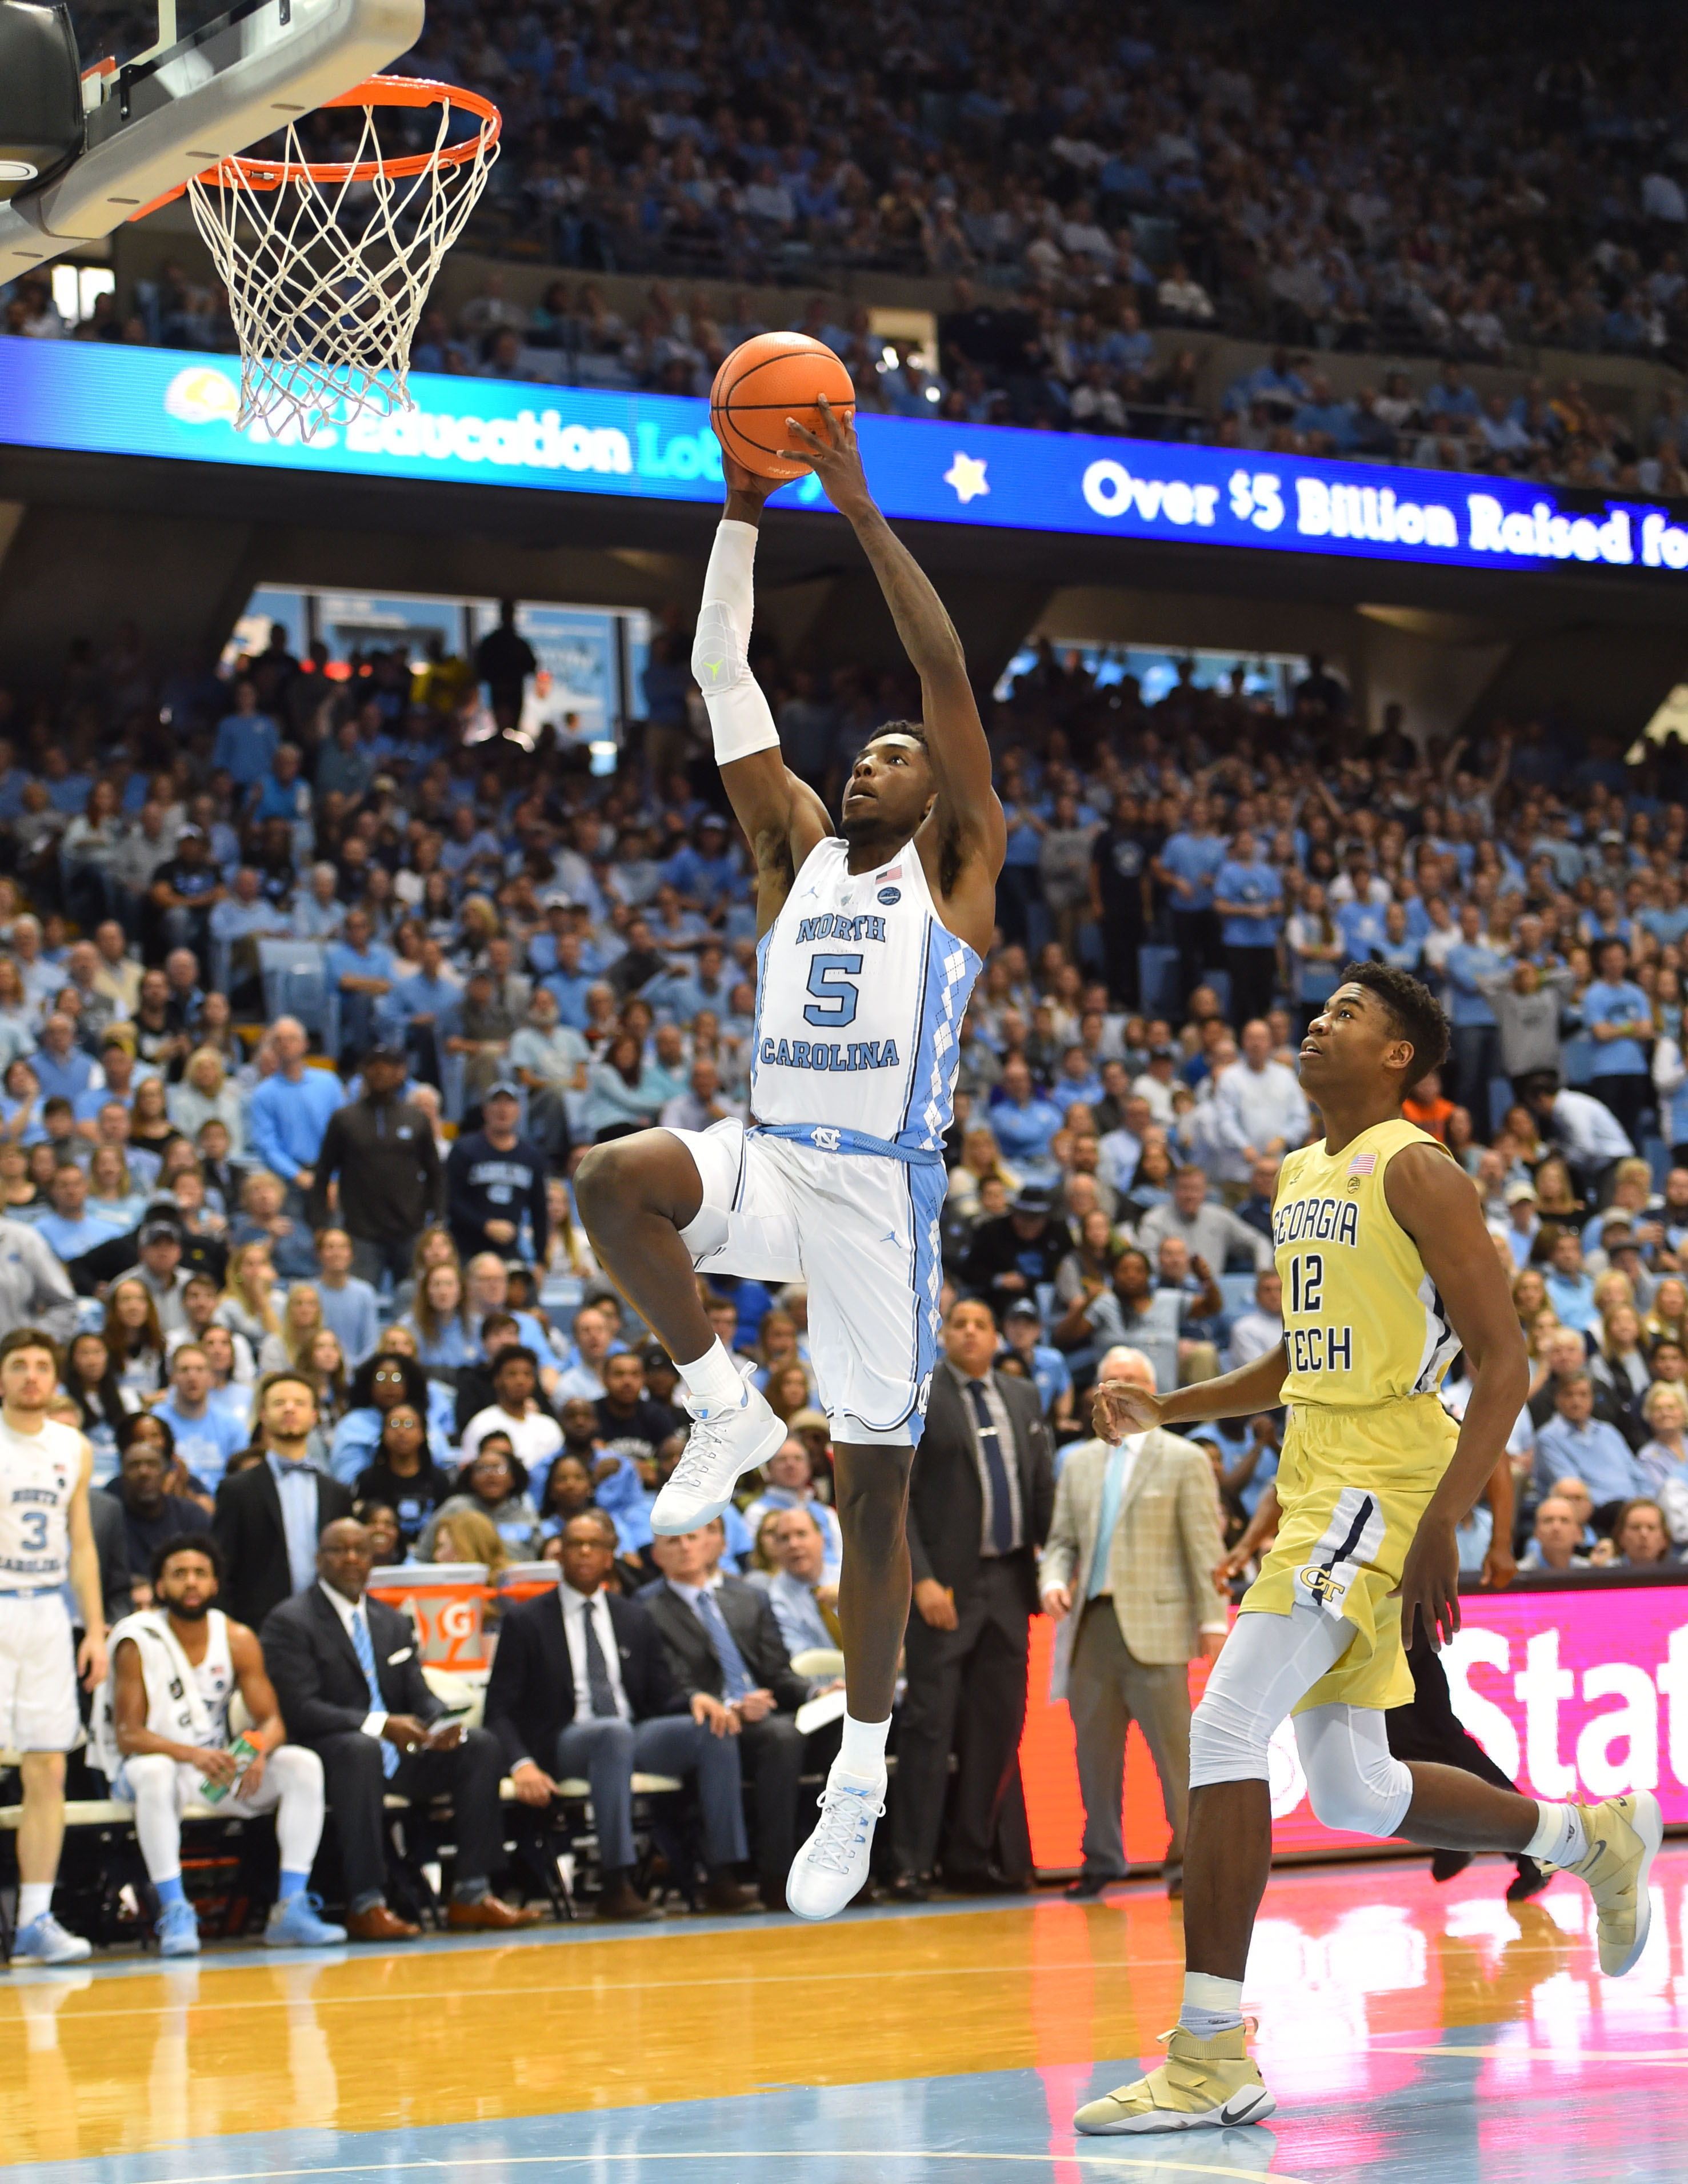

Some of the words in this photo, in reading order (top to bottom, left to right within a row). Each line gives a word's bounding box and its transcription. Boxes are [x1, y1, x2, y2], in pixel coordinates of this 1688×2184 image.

[345, 394, 632, 474] Education
[1083, 458, 1219, 528] Over
[1229, 468, 1285, 532] $5
[1295, 476, 1458, 548] Billion
[1467, 492, 1634, 566] Raised
[795, 913, 886, 945] NORTH
[803, 953, 864, 1028] 5
[760, 1037, 900, 1072] CAROLINA
[1274, 1197, 1359, 1248] GEORGIA
[1290, 1253, 1324, 1315] 12
[1283, 1325, 1353, 1374] TECH
[21, 1512, 48, 1550] 3
[1300, 1566, 1345, 1602] GT
[442, 1601, 472, 1638] G
